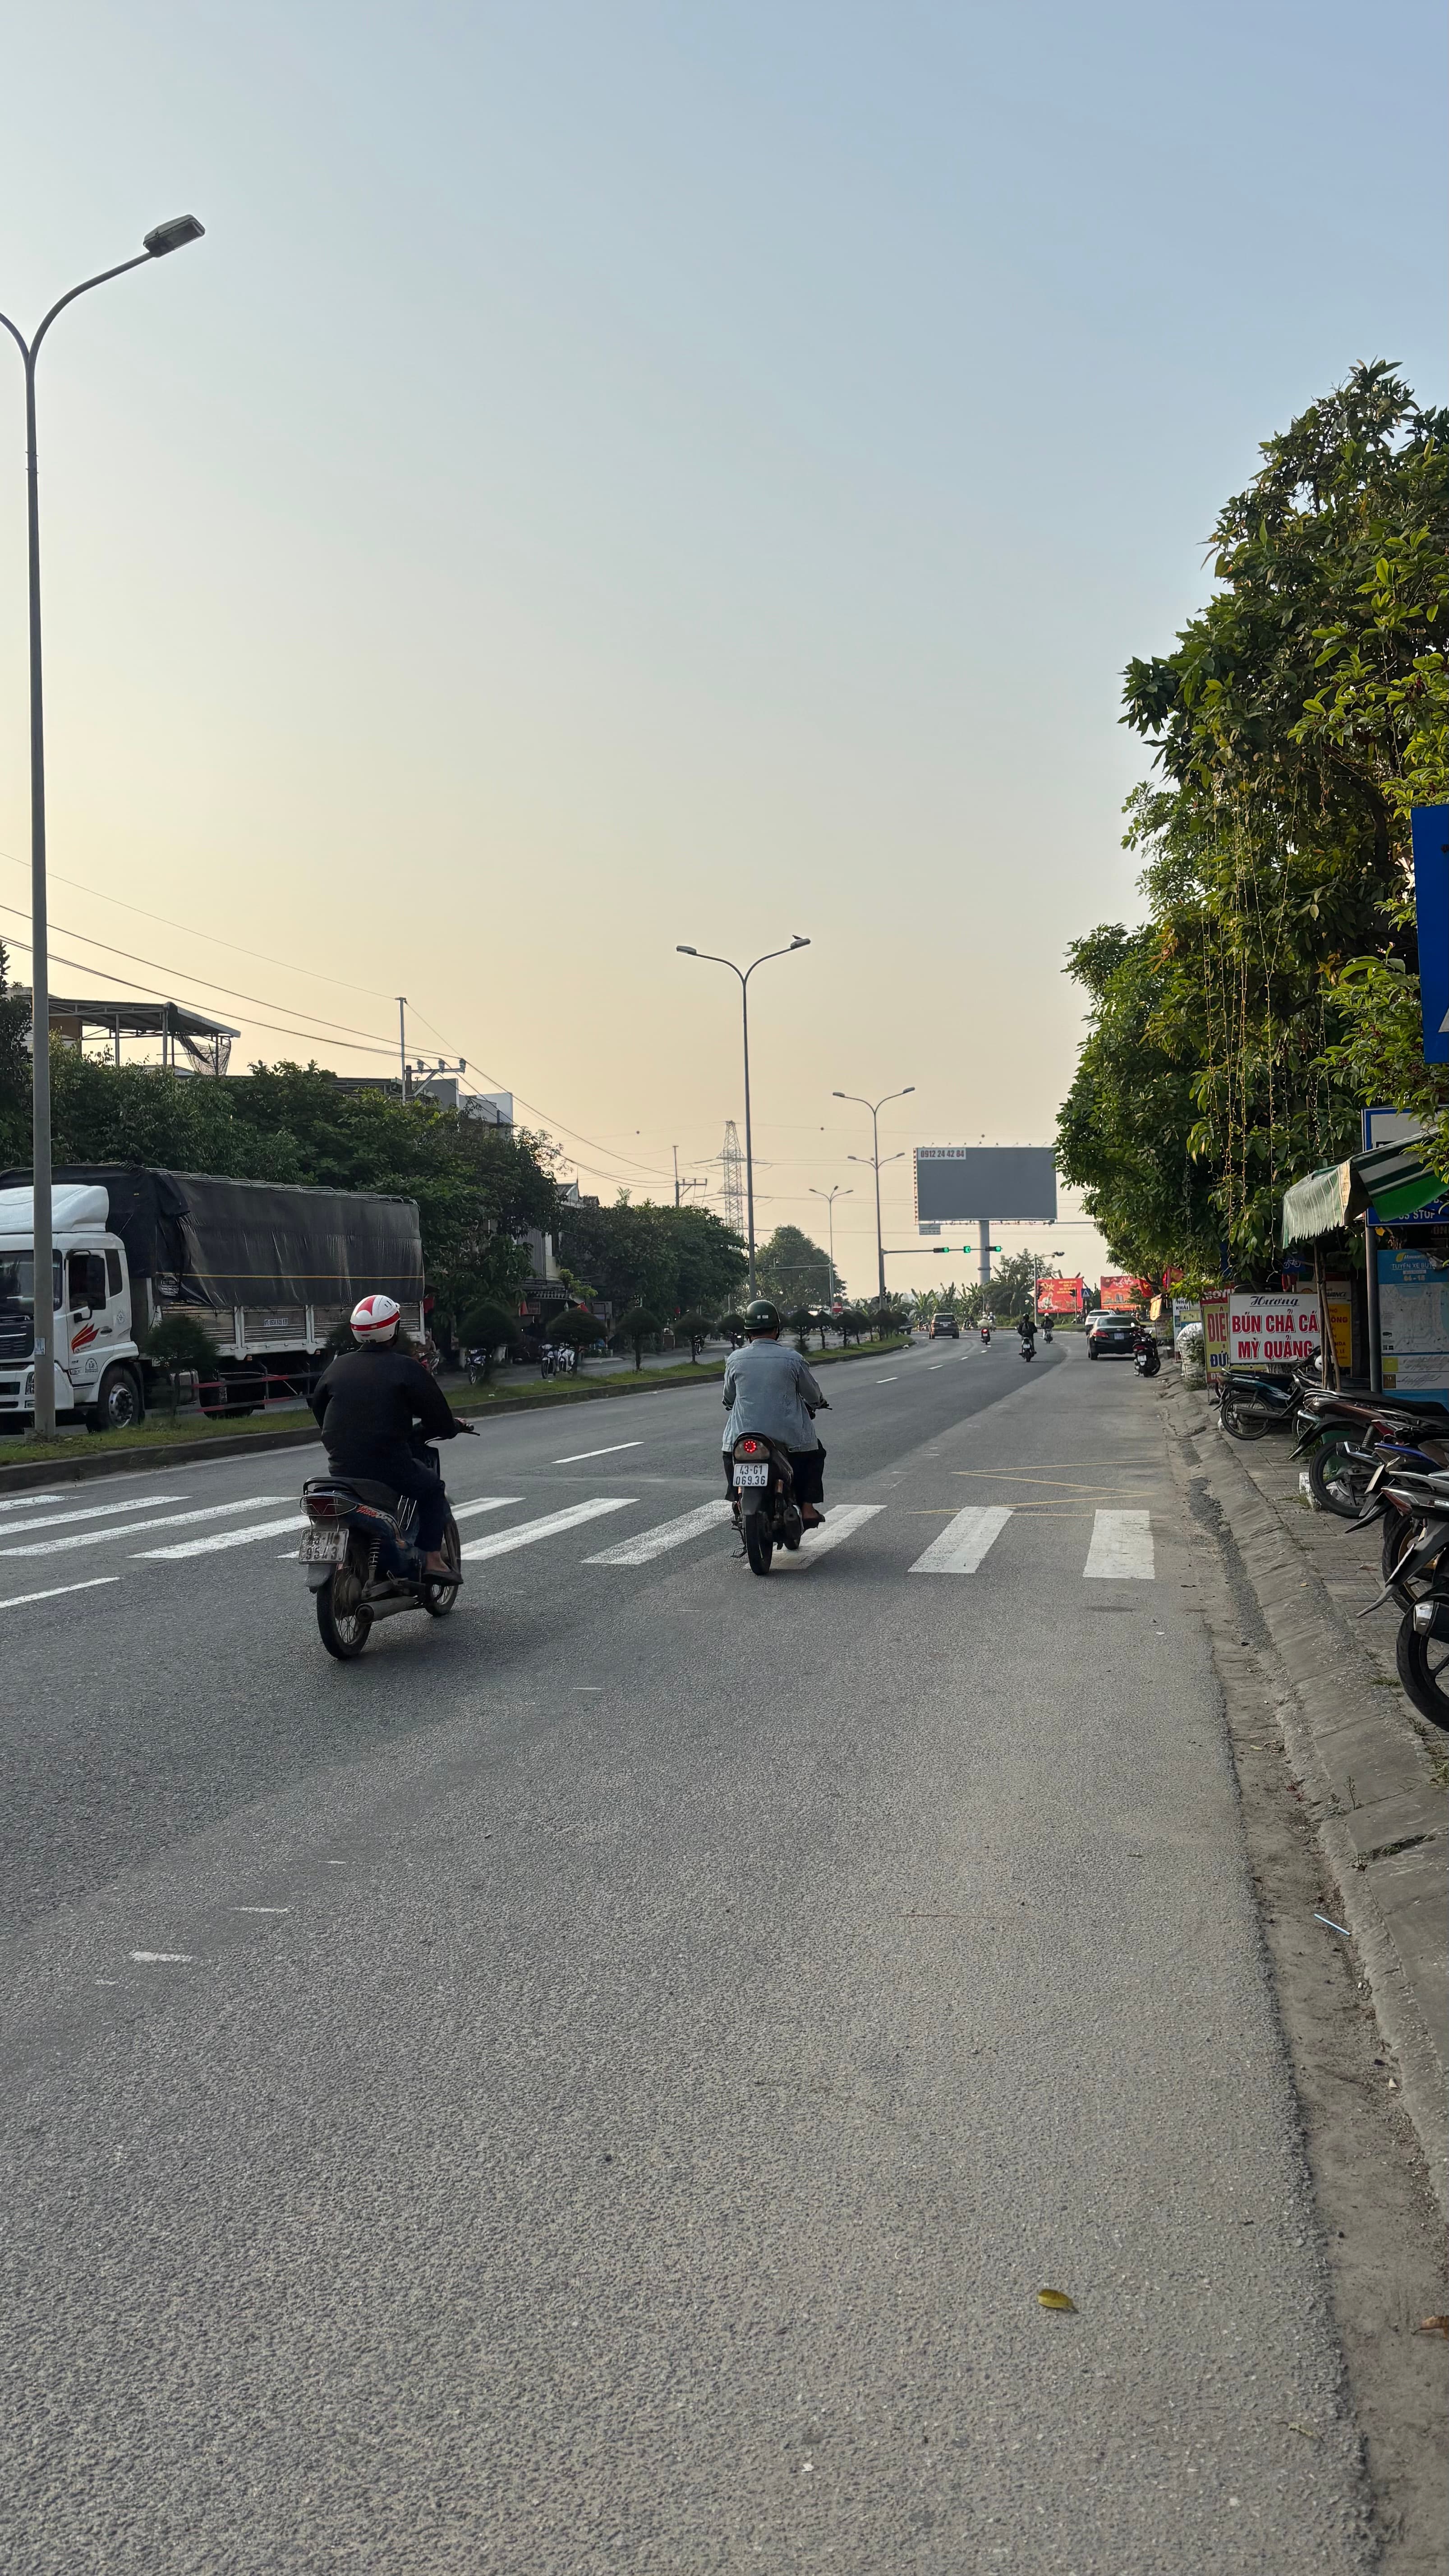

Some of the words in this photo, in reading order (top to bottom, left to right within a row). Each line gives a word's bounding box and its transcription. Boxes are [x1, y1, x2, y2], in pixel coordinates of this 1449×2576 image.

[1250, 1296, 1300, 1307] Hương
[1207, 1306, 1228, 1348] ĐIỆ
[1232, 1311, 1262, 1333] BÚN
[1265, 1309, 1295, 1333] CHẢ
[1299, 1310, 1319, 1333] CÁ
[1238, 1337, 1260, 1359] MỲ
[1264, 1334, 1313, 1360] QUẢNG
[1210, 1351, 1229, 1367] ĐỨ
[740, 1465, 762, 1475] 43-G1
[736, 1476, 765, 1485] 069.36
